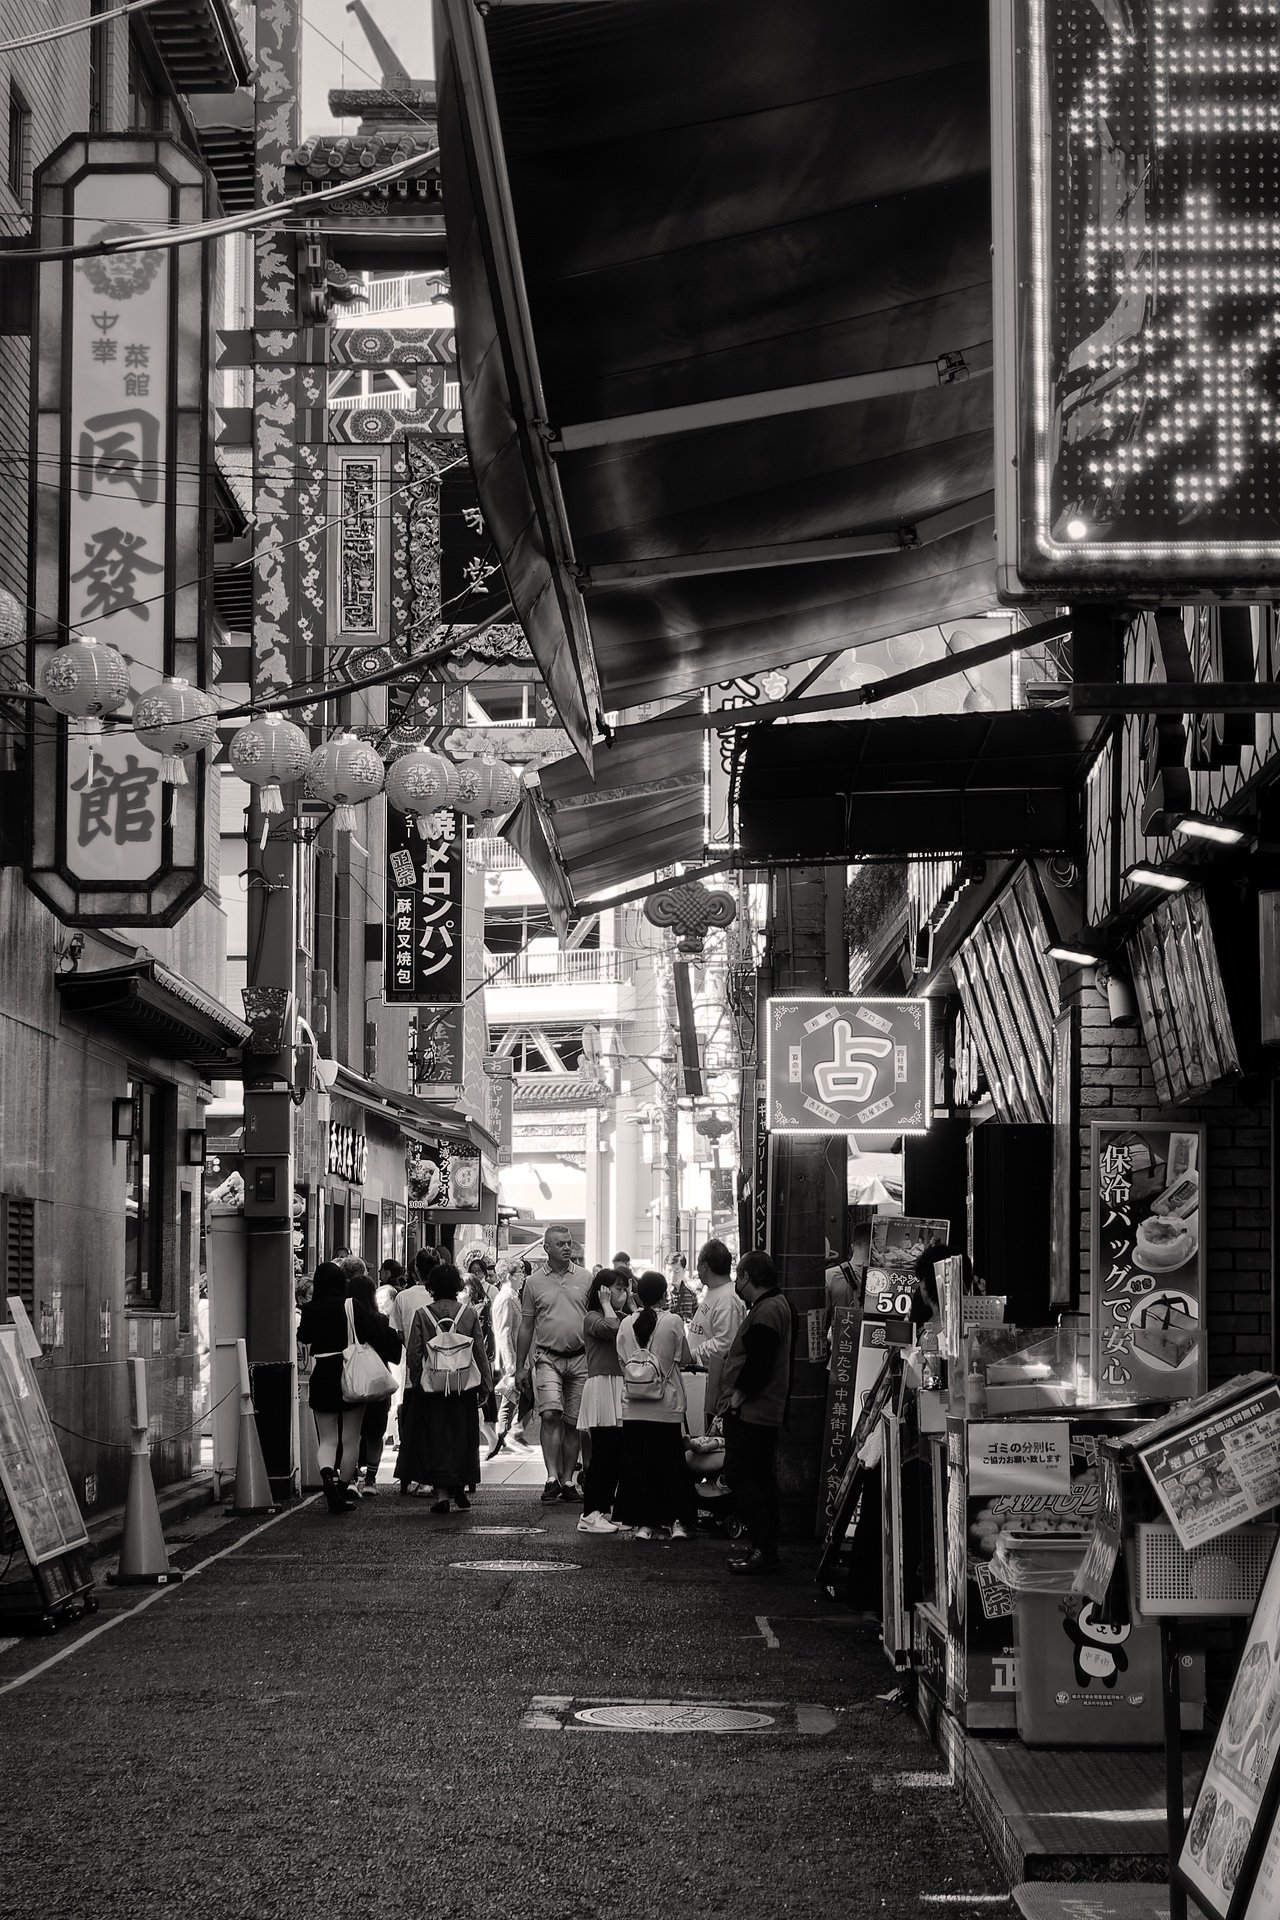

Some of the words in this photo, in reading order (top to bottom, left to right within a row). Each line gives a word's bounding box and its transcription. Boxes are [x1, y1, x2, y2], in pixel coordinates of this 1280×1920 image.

[91, 310, 119, 363] 中華
[123, 343, 150, 397] 菜館
[70, 408, 164, 847] 同發館
[396, 897, 412, 985] 酥皮叉焼包
[861, 1011, 887, 1029] タロット
[813, 1019, 893, 1103] 占
[1101, 1144, 1133, 1386] 保冷バッグで安心
[1130, 1276, 1154, 1293] 付き
[836, 1311, 854, 1383] よく当たる
[830, 1387, 849, 1458] 中華街占い
[987, 1440, 1056, 1455] ゴミの分別に
[982, 1454, 1062, 1466] ご協力お願い致します
